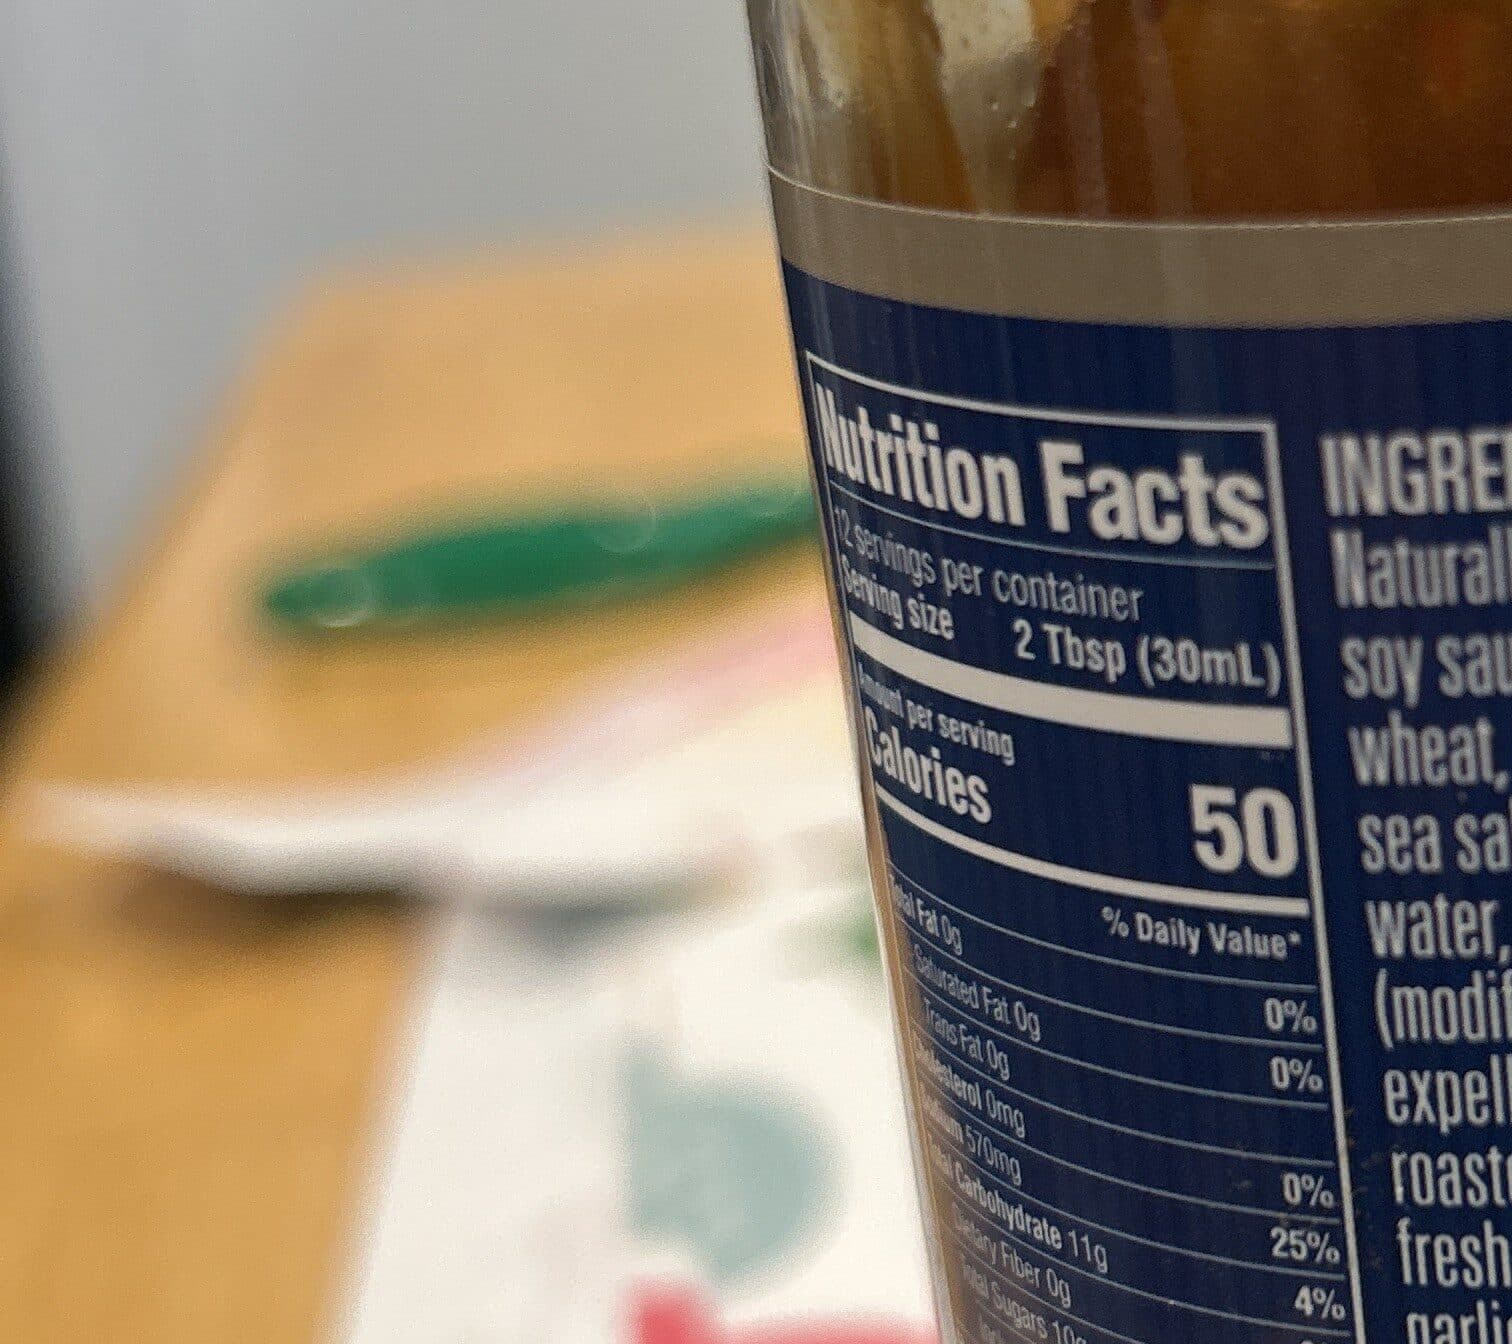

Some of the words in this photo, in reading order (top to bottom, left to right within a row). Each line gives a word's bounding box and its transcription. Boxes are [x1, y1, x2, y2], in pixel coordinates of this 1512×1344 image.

[816, 382, 1025, 526] Nutrition
[1039, 441, 1271, 549] Facts
[854, 525, 936, 588] servings
[941, 557, 984, 597] per
[994, 569, 1144, 622] container
[841, 554, 904, 631] Serving
[907, 592, 955, 640] size
[1013, 619, 1036, 661] 2
[1042, 623, 1127, 683] Tbsp
[1138, 635, 1282, 697] (30mL)
[1341, 634, 1423, 708] soy
[906, 699, 934, 732] per
[938, 713, 1016, 766] serving
[1348, 709, 1510, 792] wheat,
[864, 706, 993, 824] Calories
[1190, 783, 1299, 878] 50
[1359, 812, 1443, 873] sea
[917, 897, 940, 937] Fat
[941, 914, 963, 956] 0g
[1264, 997, 1317, 1034] 0%
[1102, 905, 1130, 939] %
[1136, 912, 1201, 955] Daily
[1364, 891, 1512, 966] water,
[960, 1023, 985, 1063] Fat
[986, 1039, 1011, 1082] 0g
[982, 985, 1011, 1026] Fat
[1014, 1001, 1041, 1043] 0g
[1271, 1056, 1324, 1093] 0%
[913, 1029, 982, 1111] olesterol
[986, 1089, 1026, 1139] 0mg
[1283, 1171, 1335, 1209] 0%
[965, 1122, 1022, 1187] 570mg
[1271, 1228, 1341, 1264] 25%
[955, 1162, 1063, 1251] Carbohydrate
[1068, 1229, 1109, 1274] 11g
[1295, 1286, 1346, 1322] 4%
[1001, 1241, 1041, 1289] Fiber
[1045, 1268, 1072, 1309] 0g
[1396, 1216, 1512, 1288] fresh
[991, 1281, 1049, 1340] Sugars
